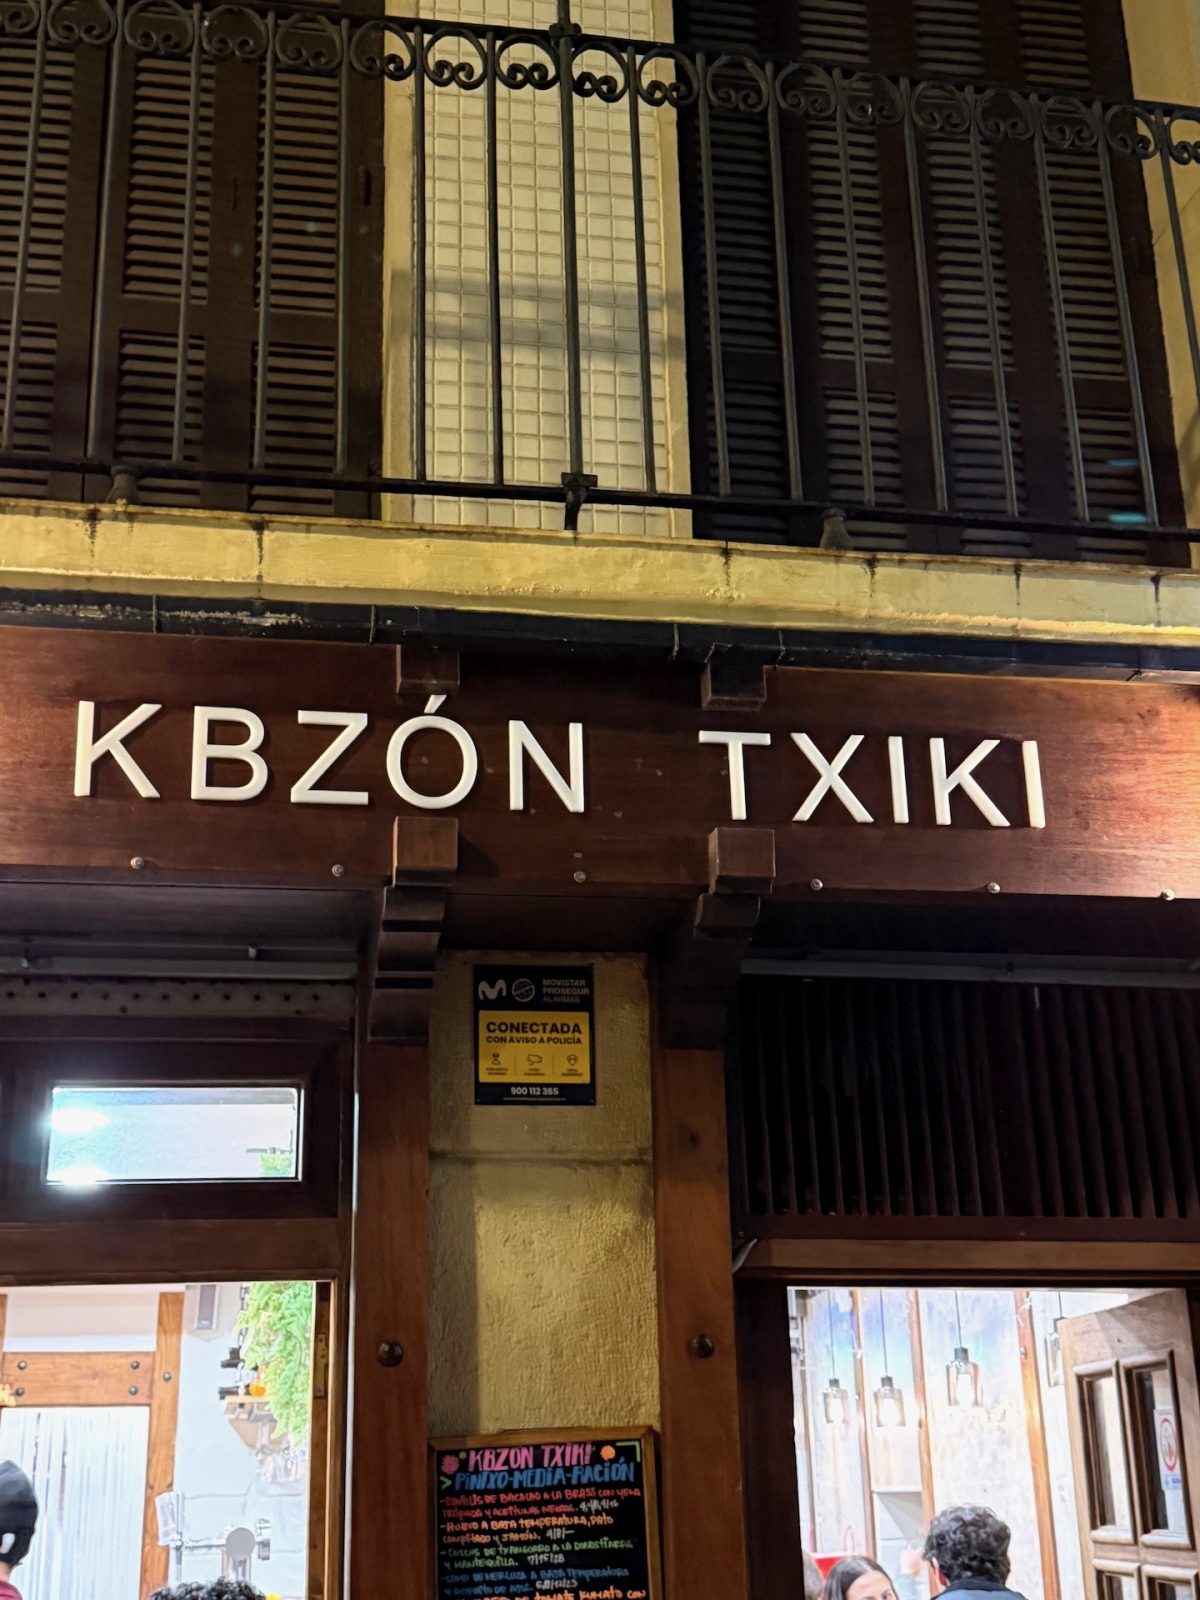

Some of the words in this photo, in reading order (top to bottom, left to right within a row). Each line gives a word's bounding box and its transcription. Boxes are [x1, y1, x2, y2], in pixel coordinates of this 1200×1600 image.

[74, 694, 585, 813] KBZÓN
[698, 731, 1046, 829] TXIKI
[542, 979, 586, 987] MOVISTAR
[542, 987, 589, 995] PROSEGUR
[487, 1022, 582, 1034] CONECTADA
[508, 1036, 537, 1044] AVISO
[547, 1036, 582, 1044] POLICÍA
[510, 1087, 528, 1095] 900
[529, 1087, 540, 1095] 112
[481, 1520, 489, 1530] A
